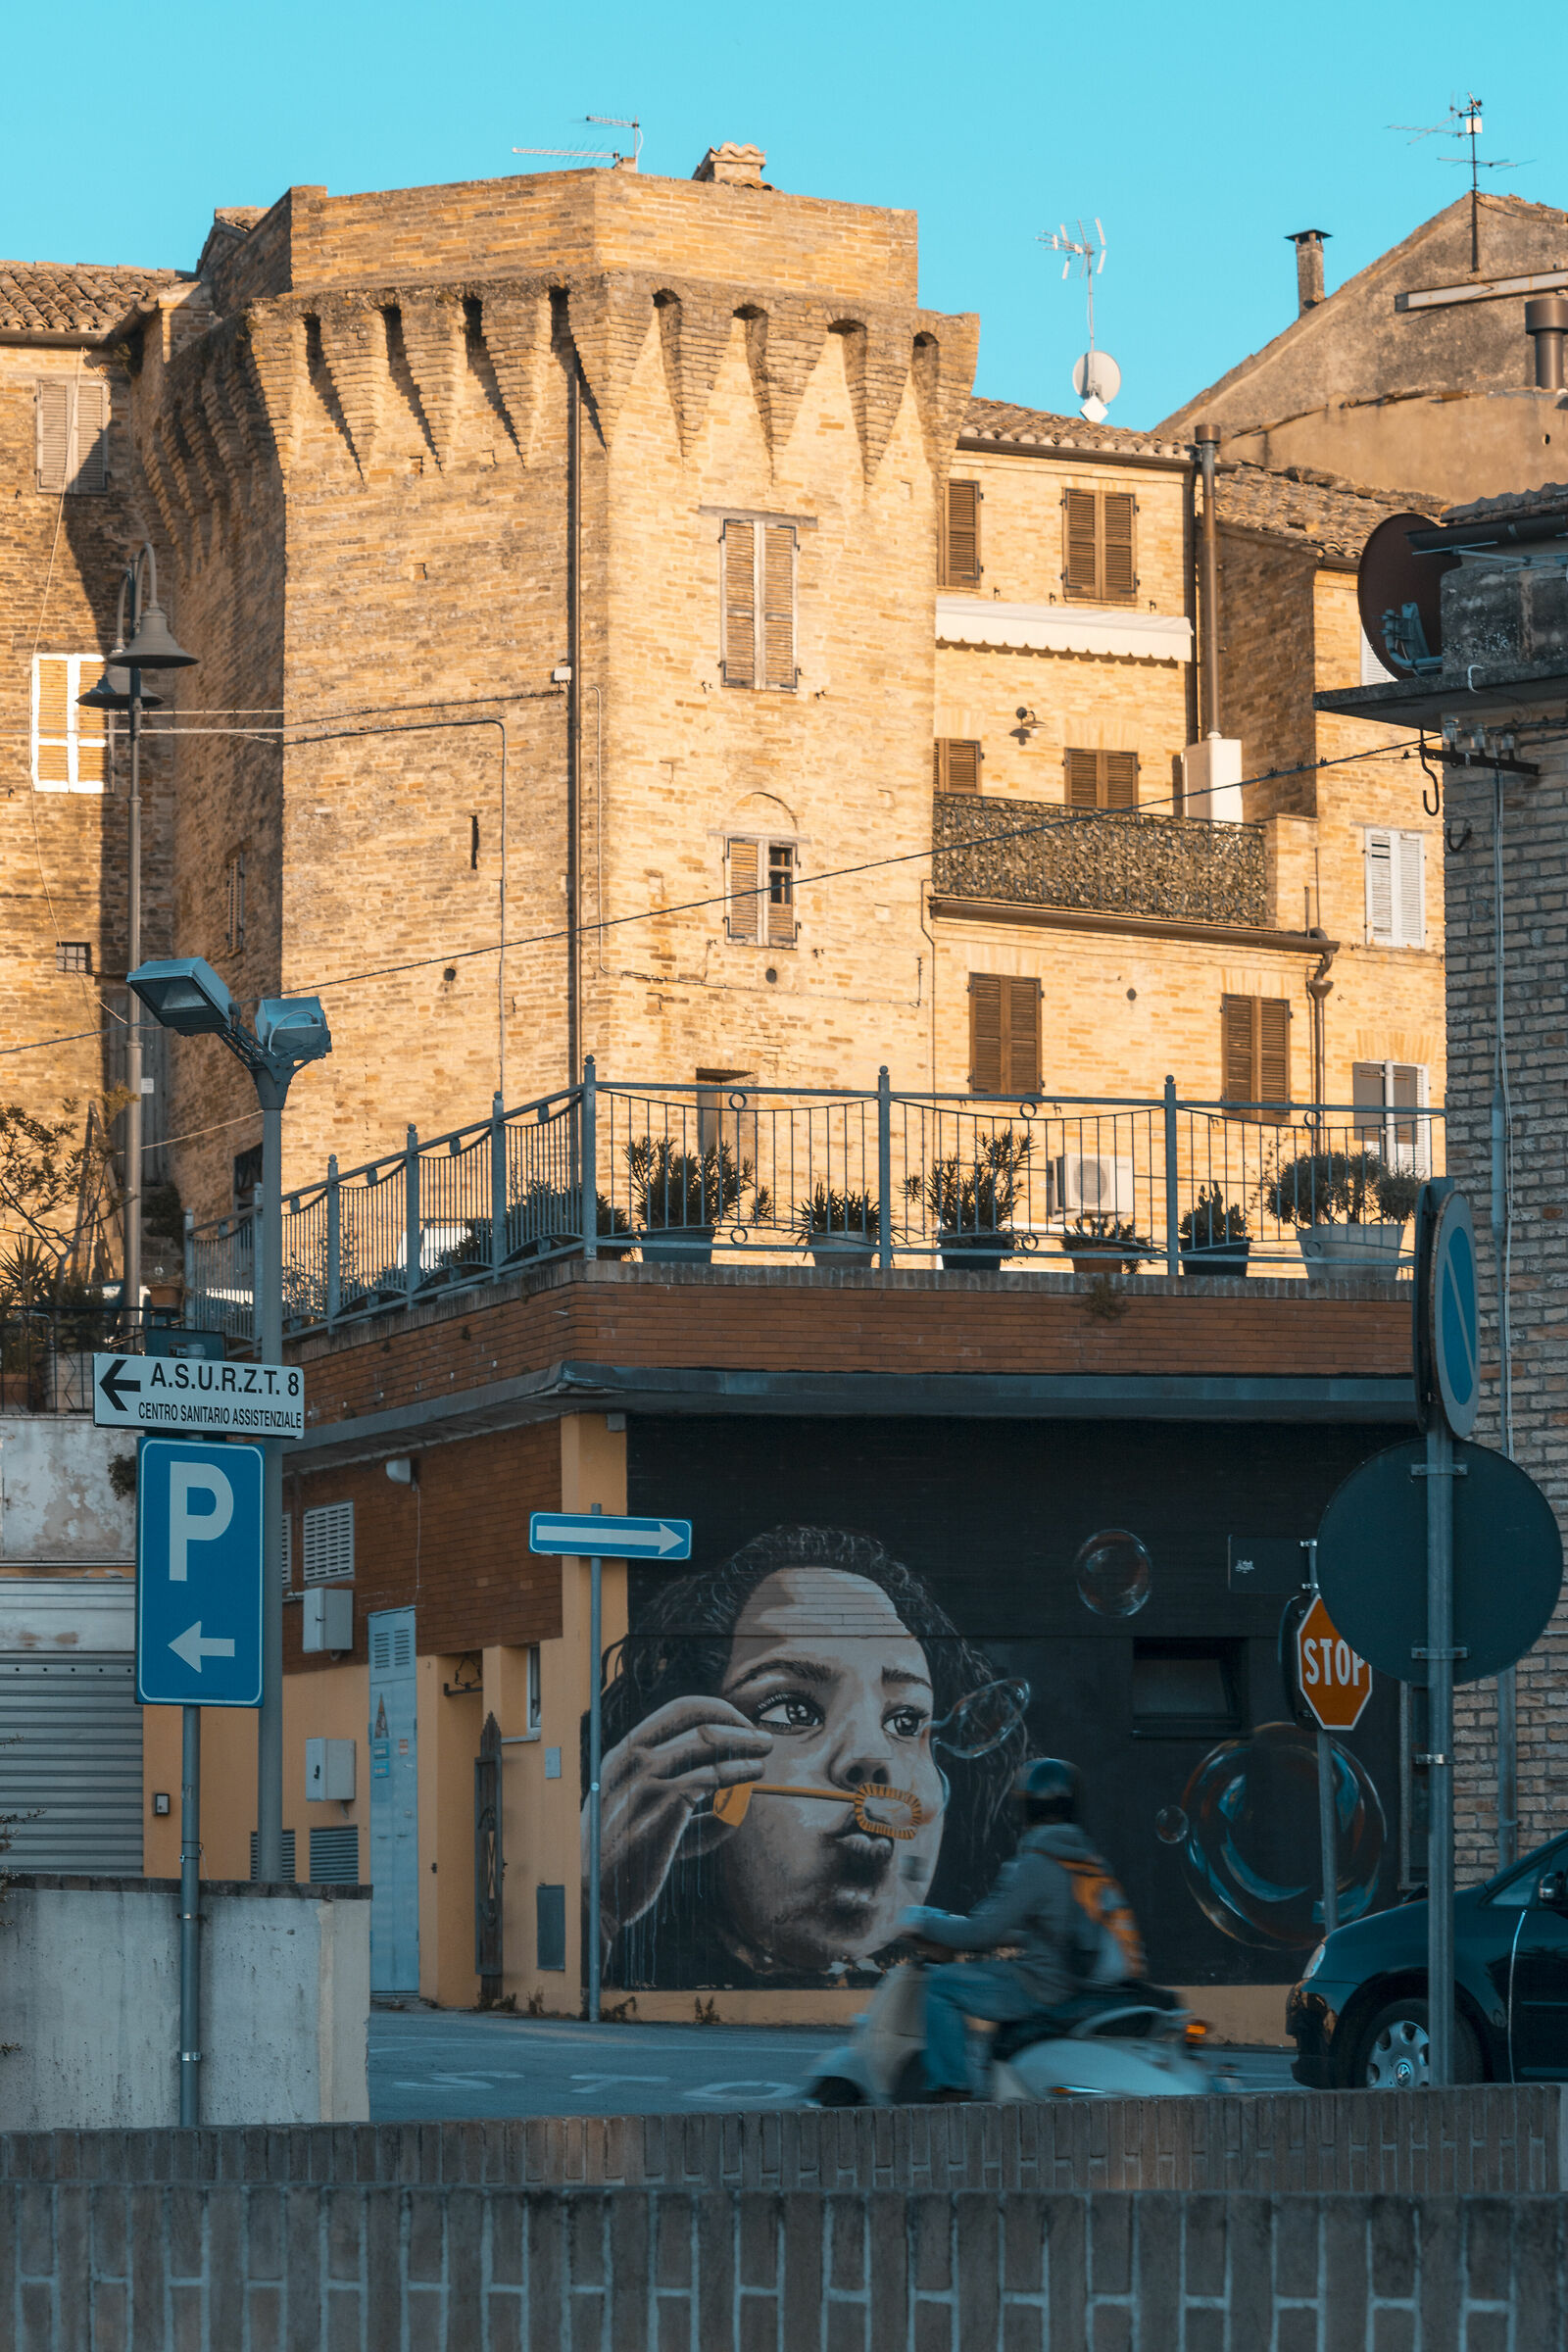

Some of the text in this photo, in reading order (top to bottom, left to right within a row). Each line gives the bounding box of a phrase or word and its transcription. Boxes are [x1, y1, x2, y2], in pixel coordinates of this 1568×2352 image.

[150, 1362, 299, 1396] A.S.U.R.Z.T. 8
[138, 1401, 302, 1429] CENTRO SANITARIO ASSISTENZIALE
[169, 1460, 234, 1581] P
[1303, 1638, 1365, 1686] STOP
[394, 2071, 804, 2102] STO
